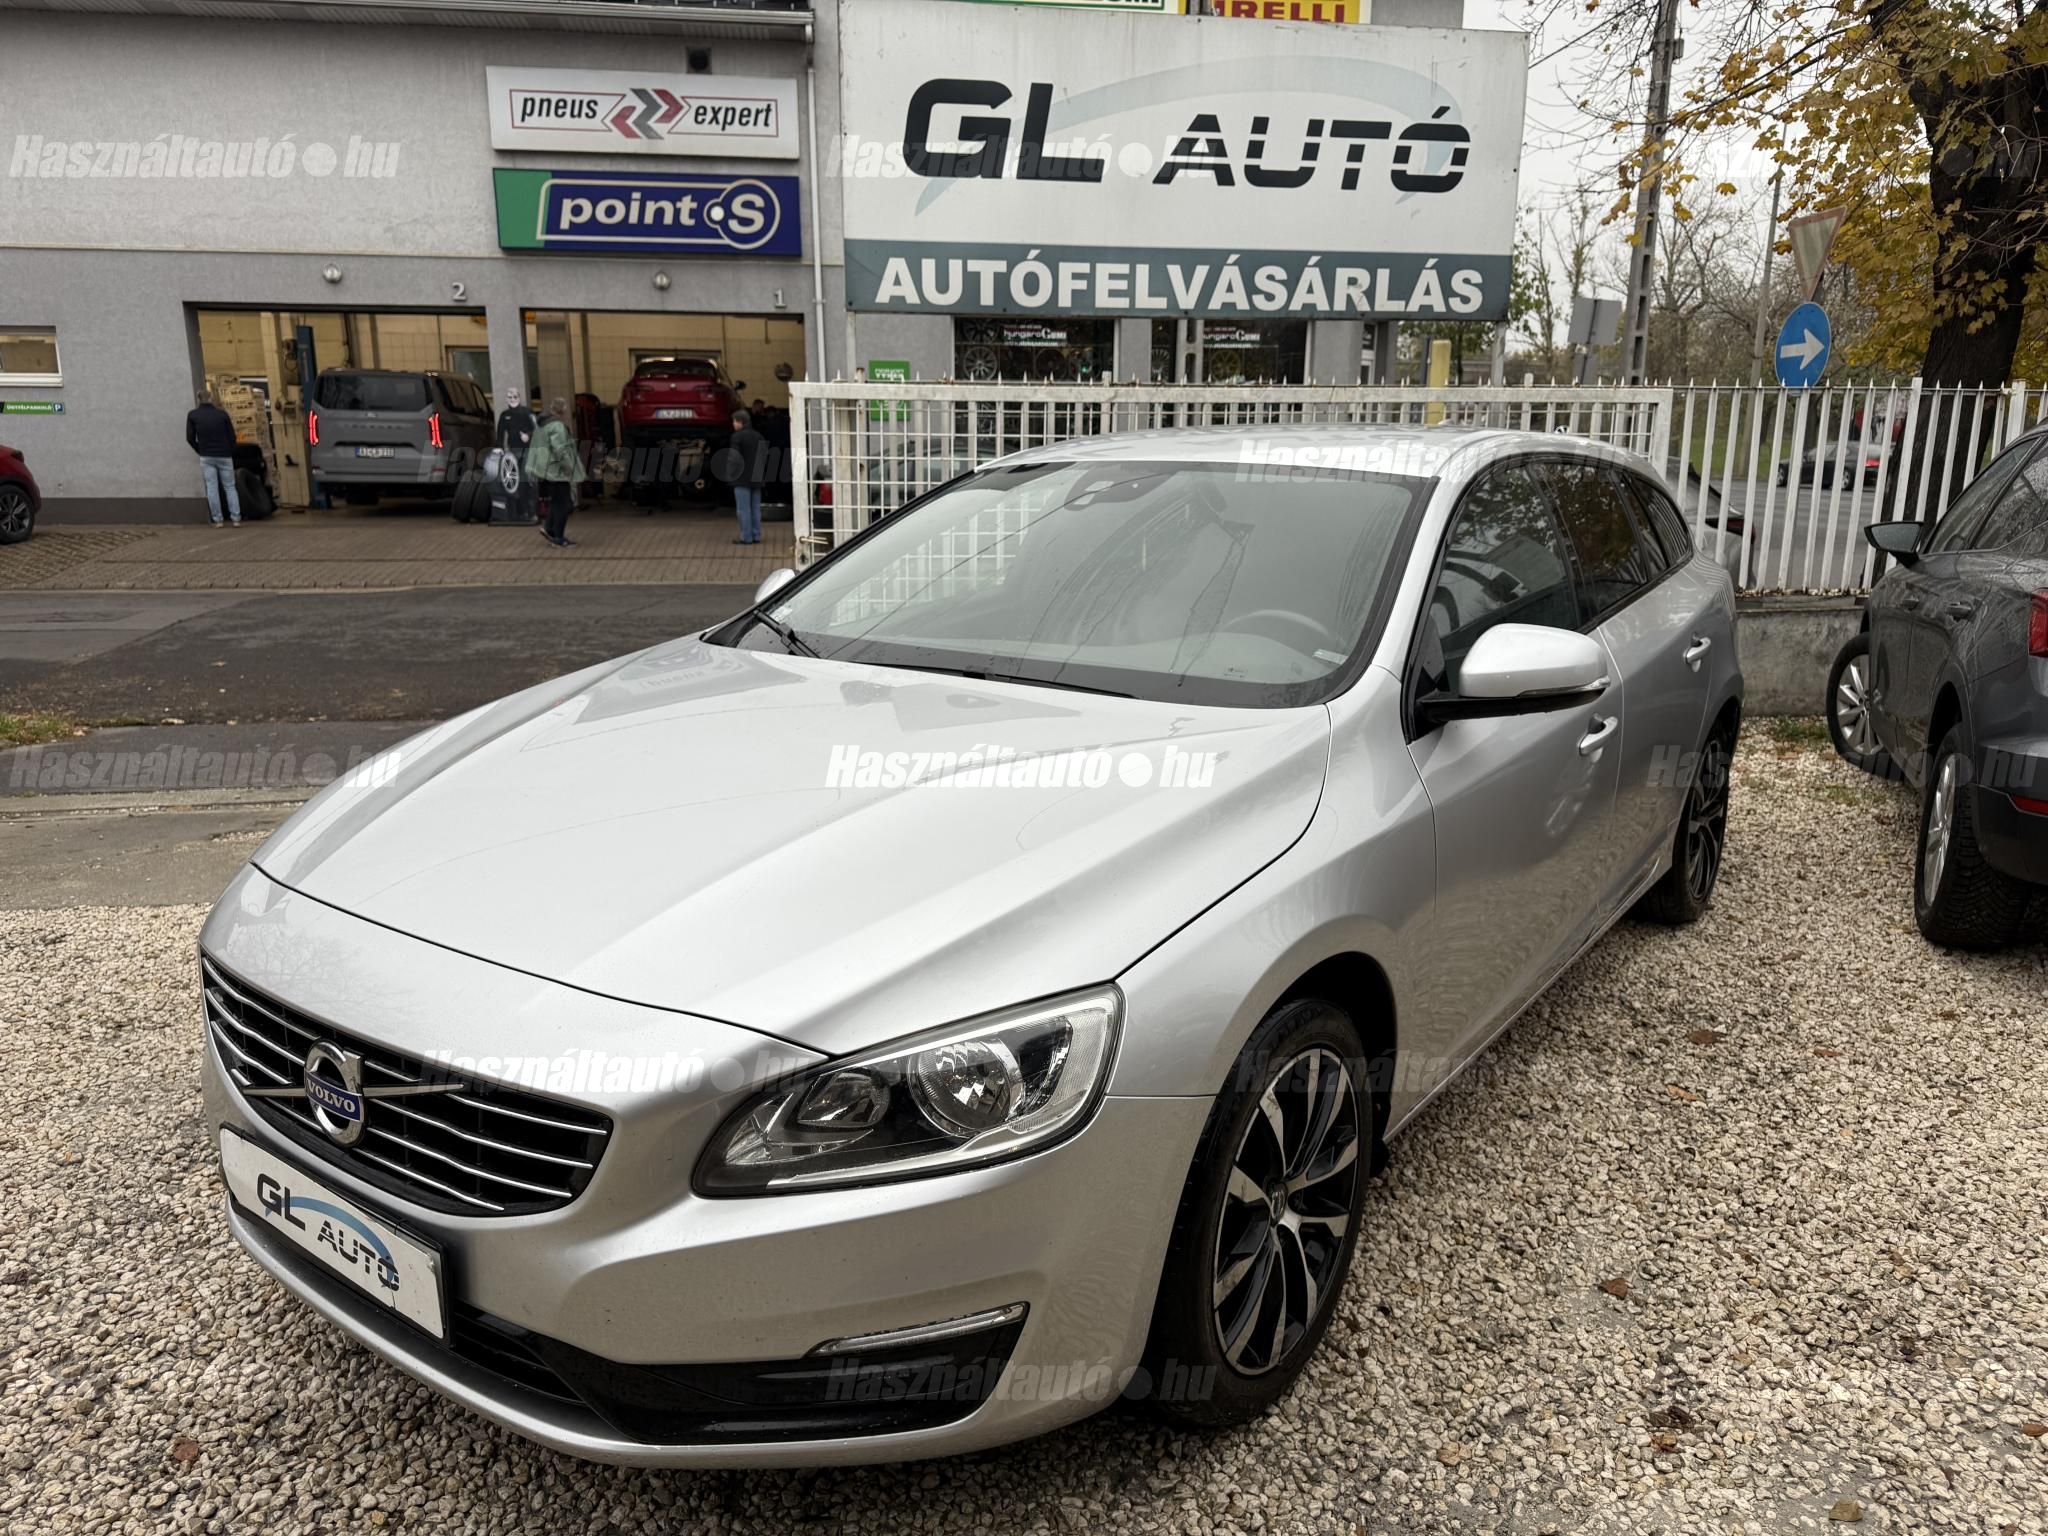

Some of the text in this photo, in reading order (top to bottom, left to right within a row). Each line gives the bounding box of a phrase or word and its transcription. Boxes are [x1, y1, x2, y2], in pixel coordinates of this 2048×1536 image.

[1213, 0, 1345, 23] IRELLI
[520, 95, 773, 132] pneus expert
[903, 77, 1472, 194] GL AUTÓ
[558, 191, 766, 235] point S
[451, 281, 467, 302] 2
[773, 288, 788, 309] 1
[875, 249, 1484, 314] AUTÓFELVÁSÁRLÁS
[306, 1079, 356, 1114] VOLVO
[256, 1172, 306, 1232] GL
